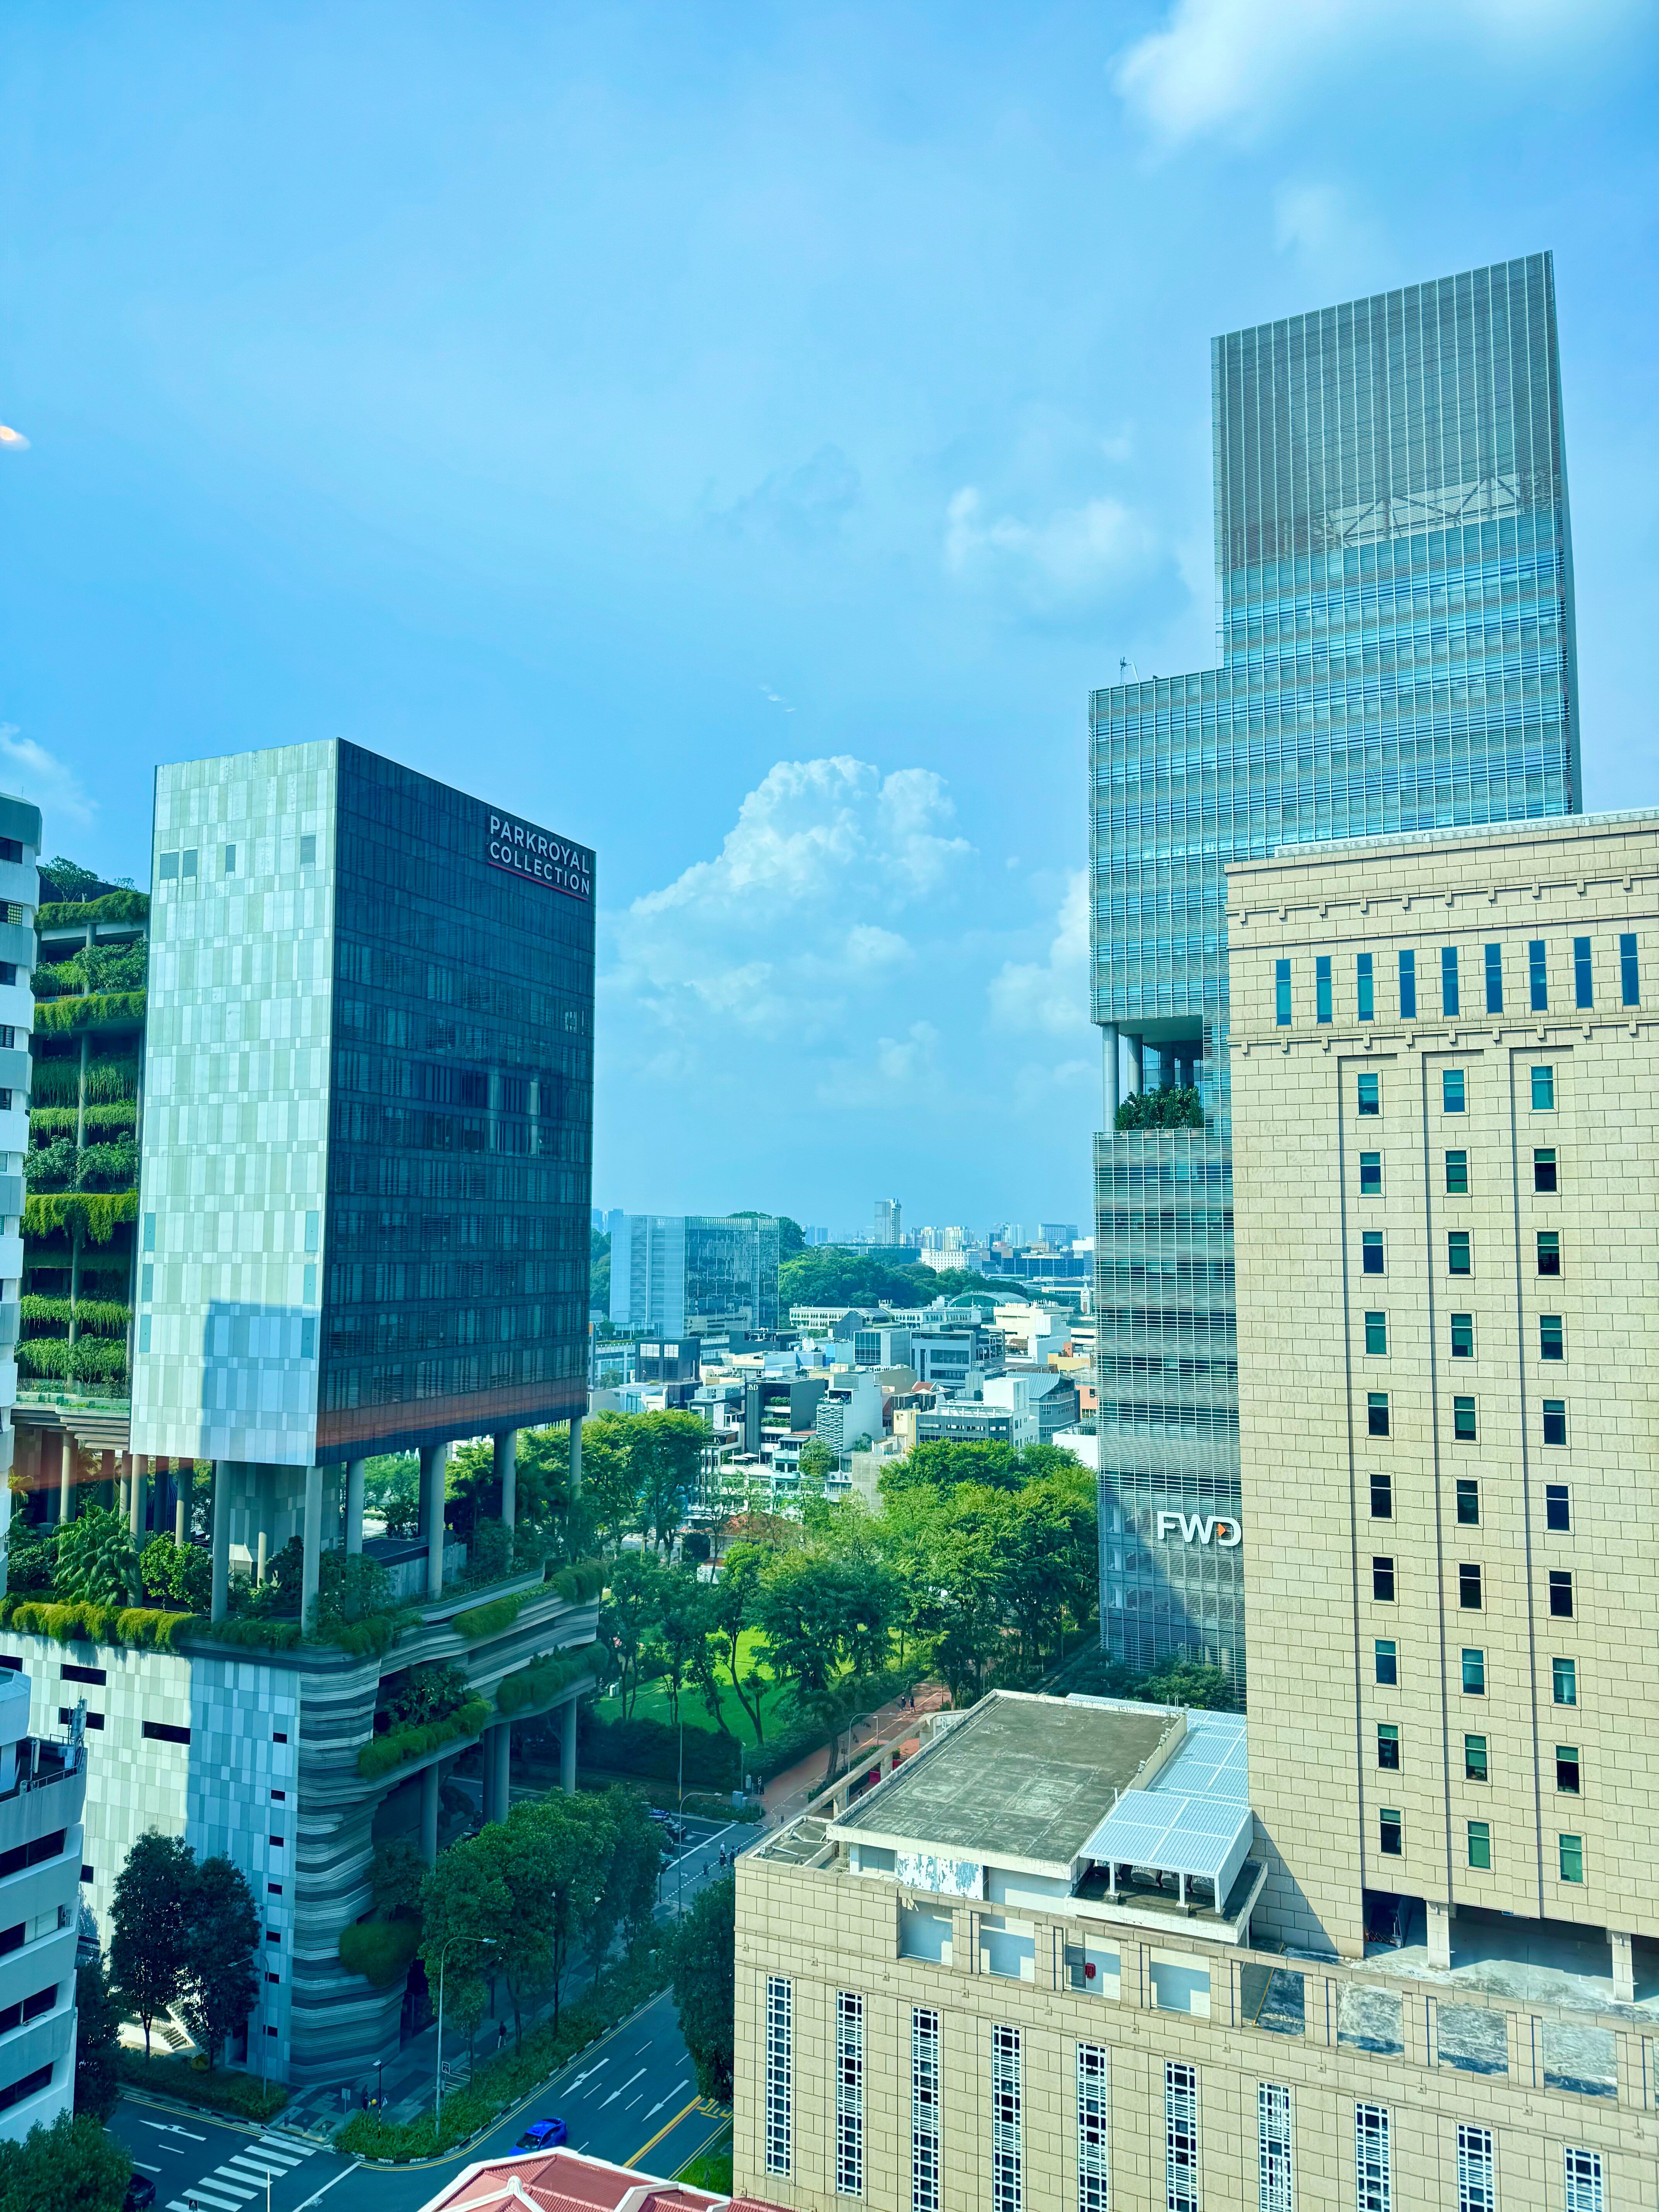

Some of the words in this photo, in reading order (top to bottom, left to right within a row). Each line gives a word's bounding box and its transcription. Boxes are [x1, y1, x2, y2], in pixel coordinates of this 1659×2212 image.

[490, 815, 589, 874] PARKROYAL
[490, 842, 589, 895] COLLECTION
[1157, 1511, 1242, 1547] FWD
